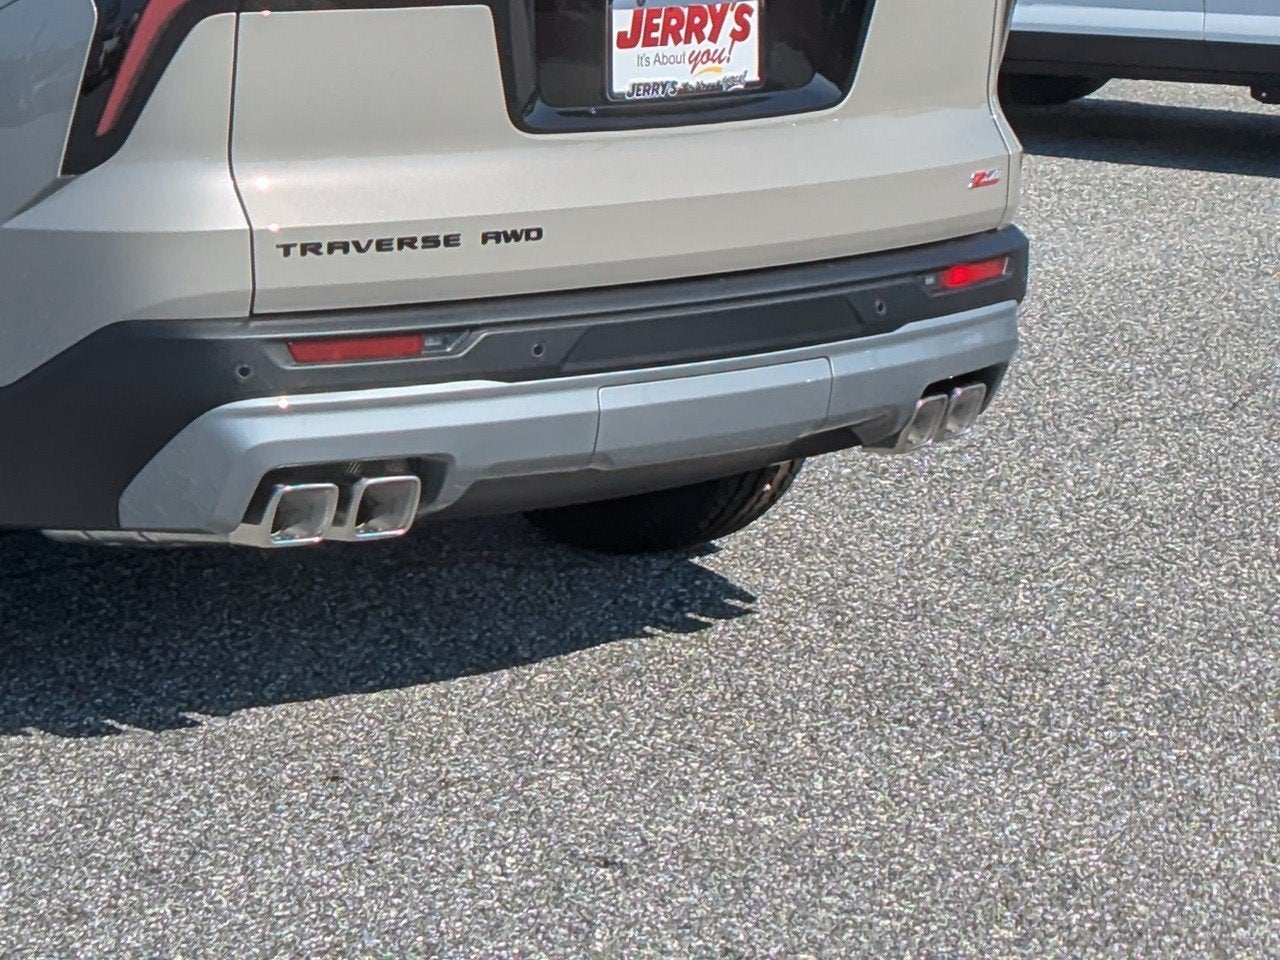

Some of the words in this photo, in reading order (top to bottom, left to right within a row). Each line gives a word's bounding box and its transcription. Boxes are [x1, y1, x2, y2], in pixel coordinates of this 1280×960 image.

[616, 2, 754, 49] JERRY'S
[637, 53, 651, 67] It's
[653, 52, 686, 66] About
[687, 40, 734, 74] you!
[626, 79, 679, 99] JERRY'S
[275, 233, 462, 258] TRAVERSE
[480, 227, 543, 245] AWD
